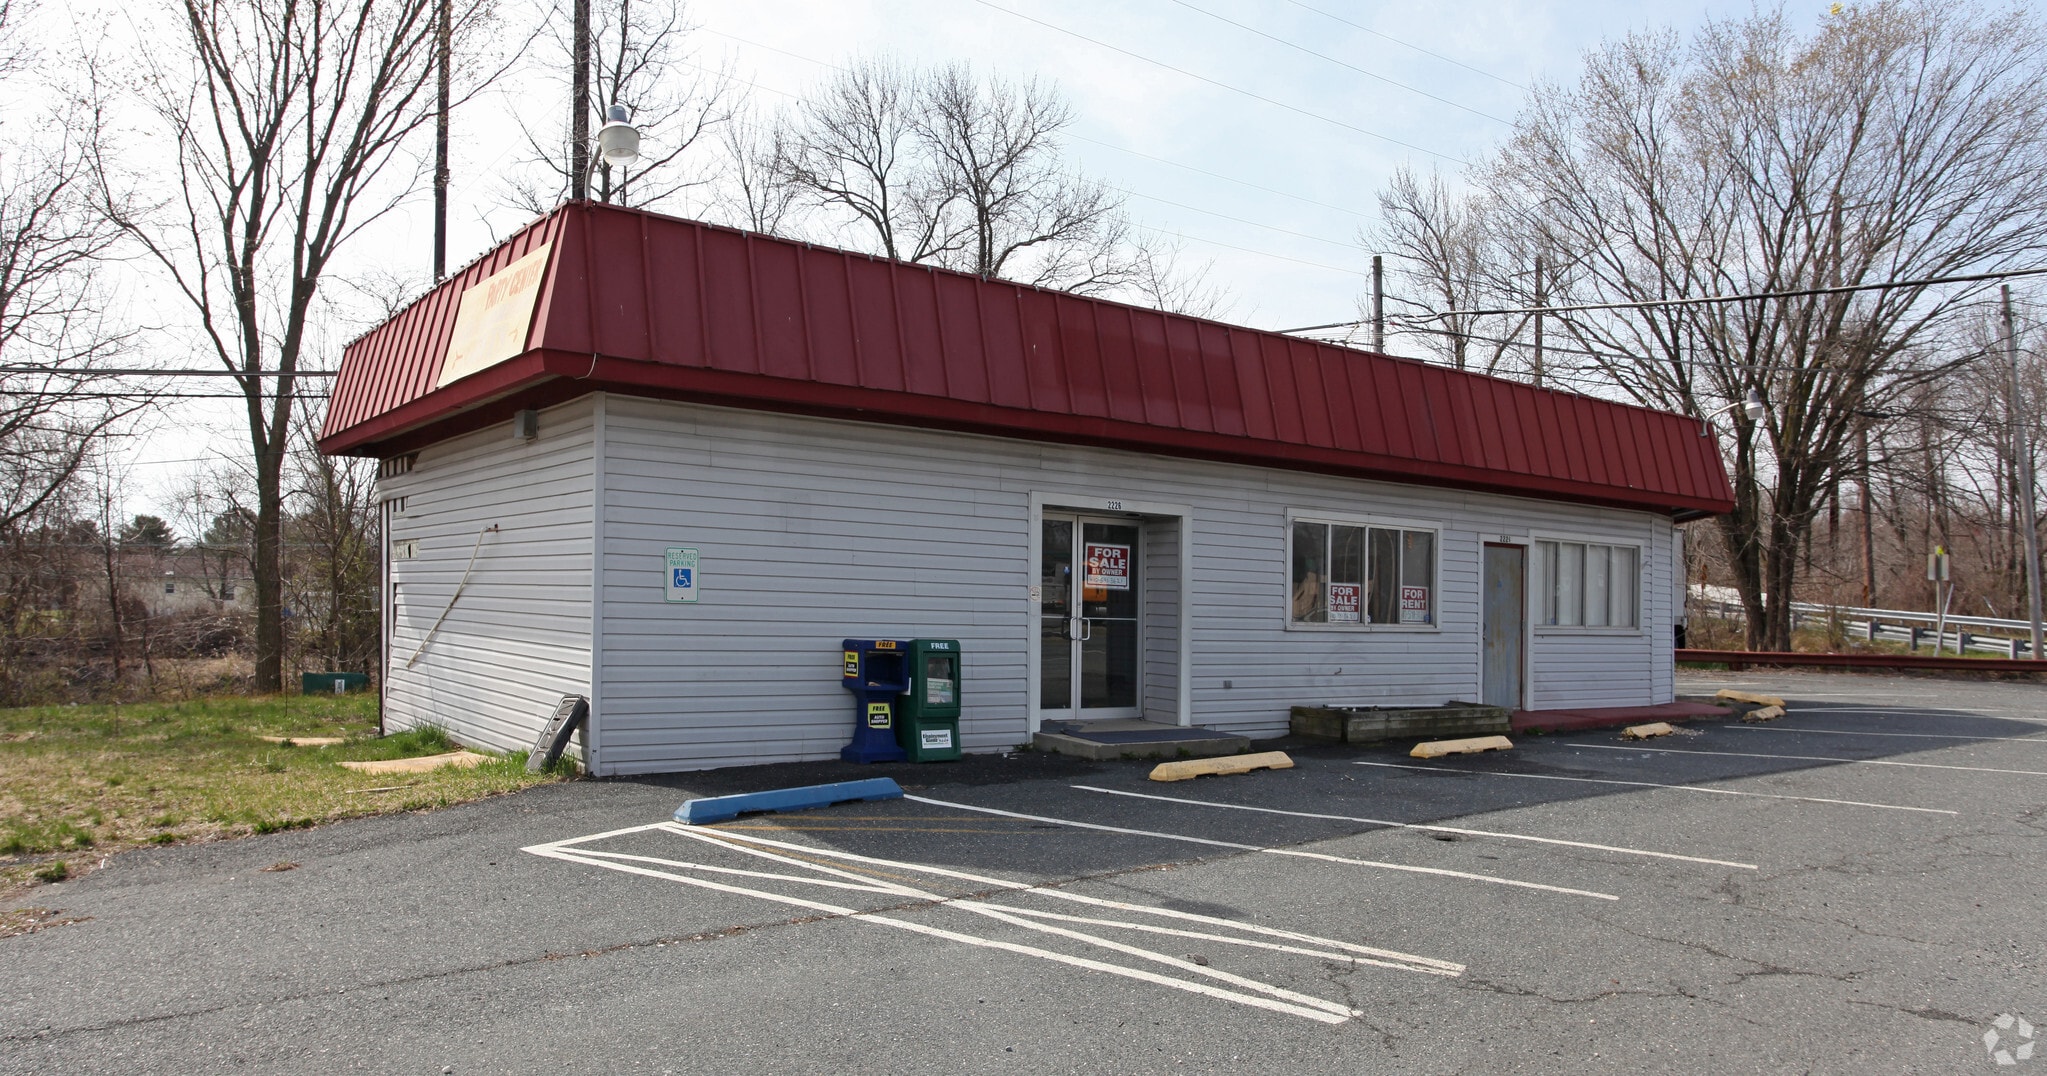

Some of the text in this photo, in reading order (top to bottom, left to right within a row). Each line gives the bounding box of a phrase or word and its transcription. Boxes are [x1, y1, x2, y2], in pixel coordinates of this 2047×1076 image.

[1108, 500, 1121, 510] 2226
[668, 552, 696, 560] RESERVED
[1094, 548, 1120, 558] FOR
[1089, 556, 1126, 569] SALE
[1332, 586, 1353, 596] FOR
[1404, 589, 1423, 599] FOR
[1329, 595, 1358, 605] SALE
[1402, 599, 1426, 609] RENT
